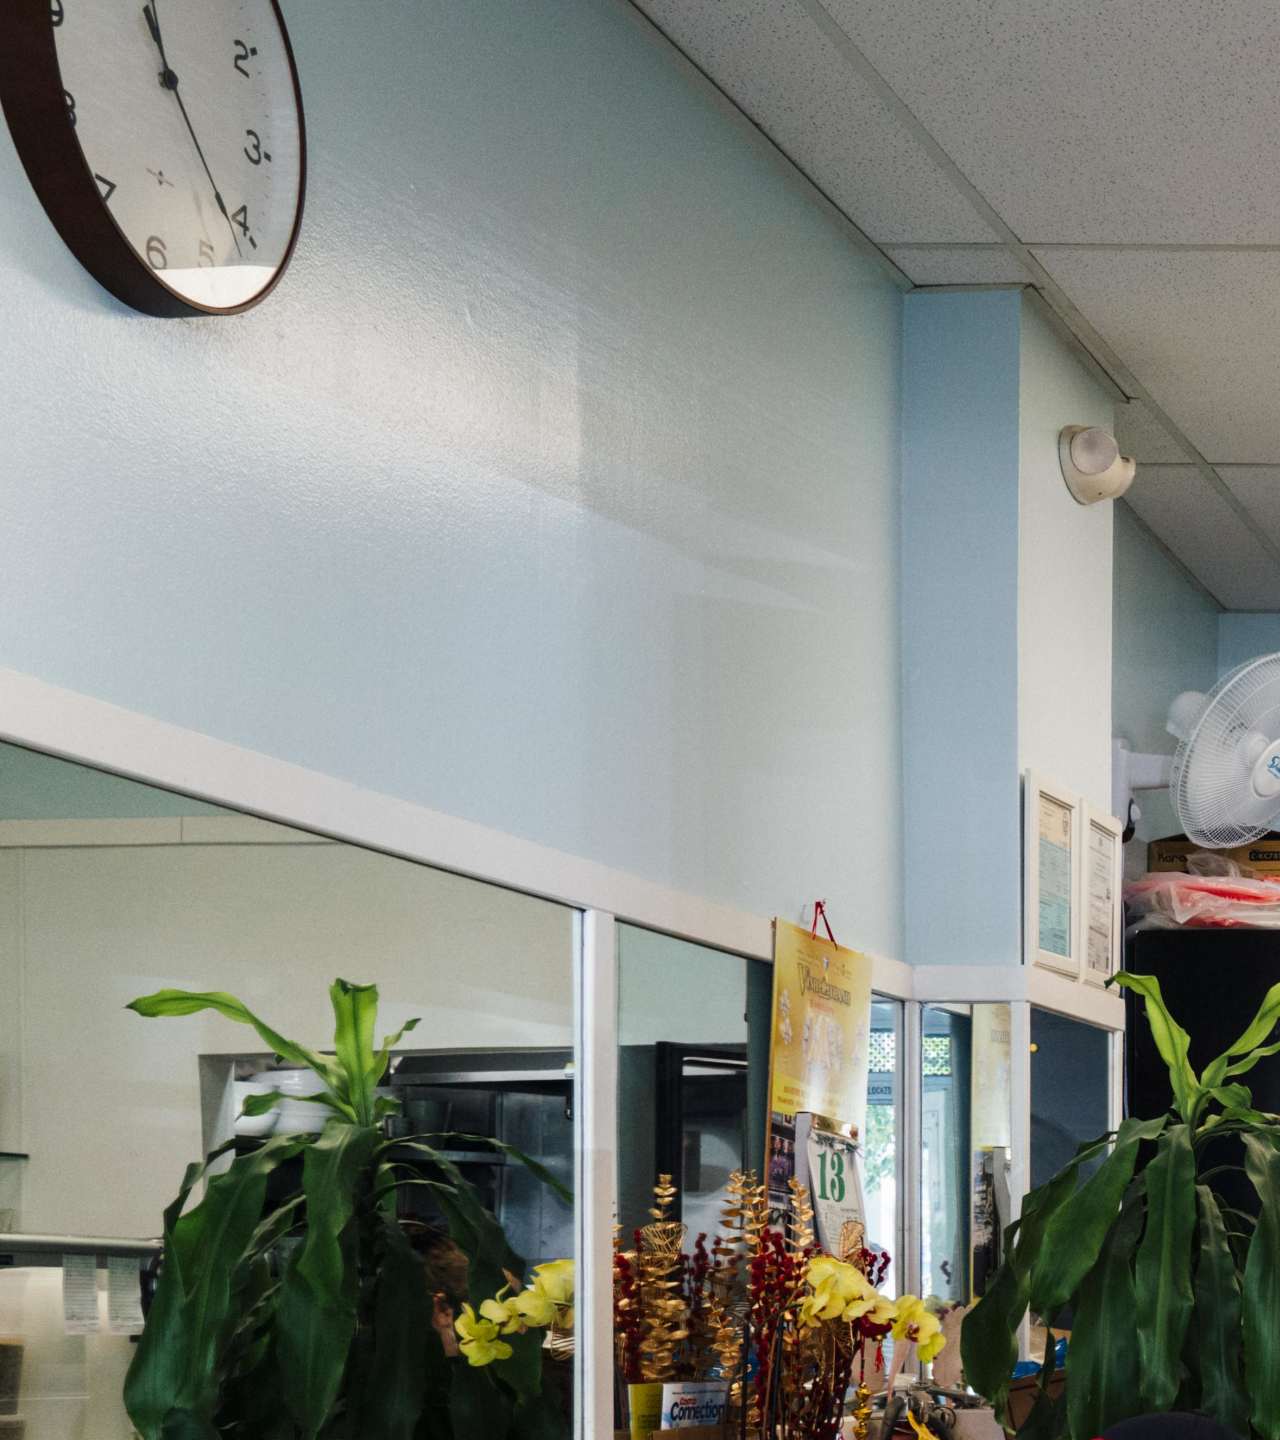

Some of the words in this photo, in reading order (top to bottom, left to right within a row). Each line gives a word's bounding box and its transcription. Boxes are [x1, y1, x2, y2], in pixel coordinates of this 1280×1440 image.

[233, 39, 251, 79] 2
[244, 128, 262, 166] 3
[230, 203, 251, 238] 4
[146, 235, 168, 270] 6
[816, 1150, 847, 1203] 13
